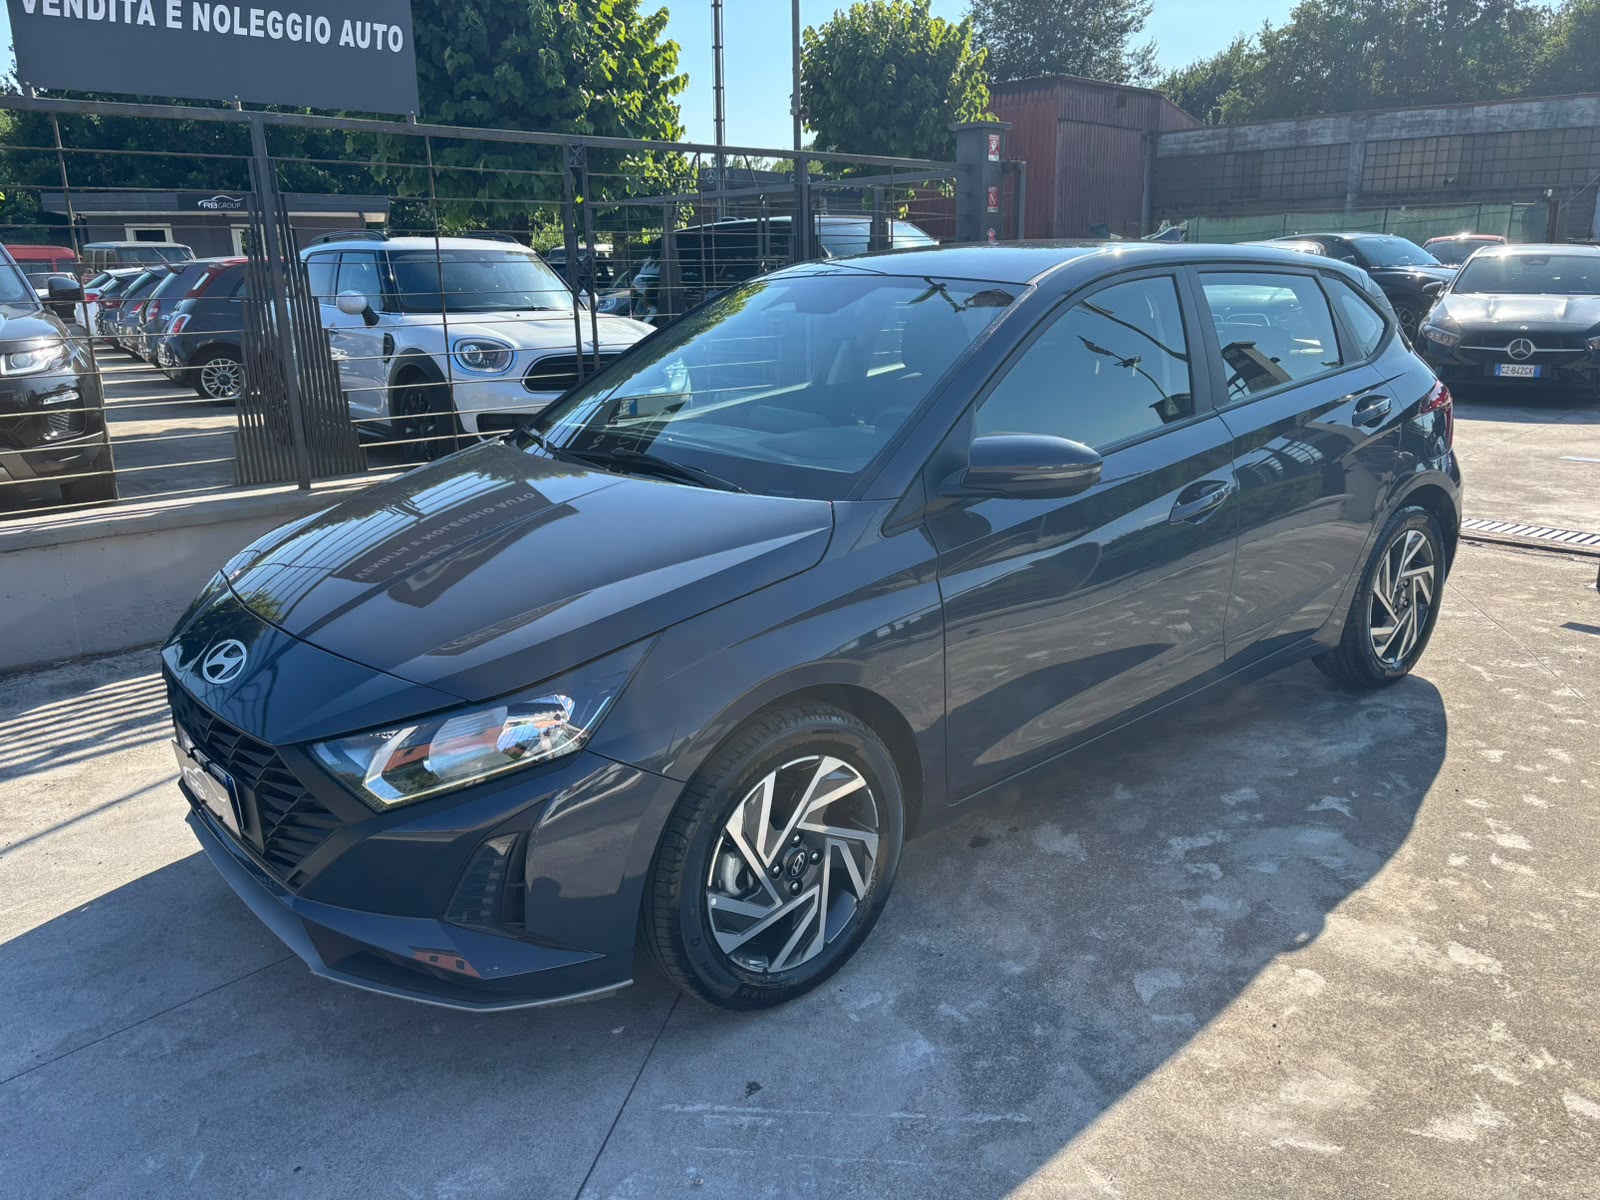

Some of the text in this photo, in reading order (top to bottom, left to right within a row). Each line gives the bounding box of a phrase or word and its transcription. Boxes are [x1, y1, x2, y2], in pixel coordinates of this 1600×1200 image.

[166, 0, 183, 29] E
[192, 1, 331, 45] NOLEGGIO
[339, 19, 404, 53] AUTO
